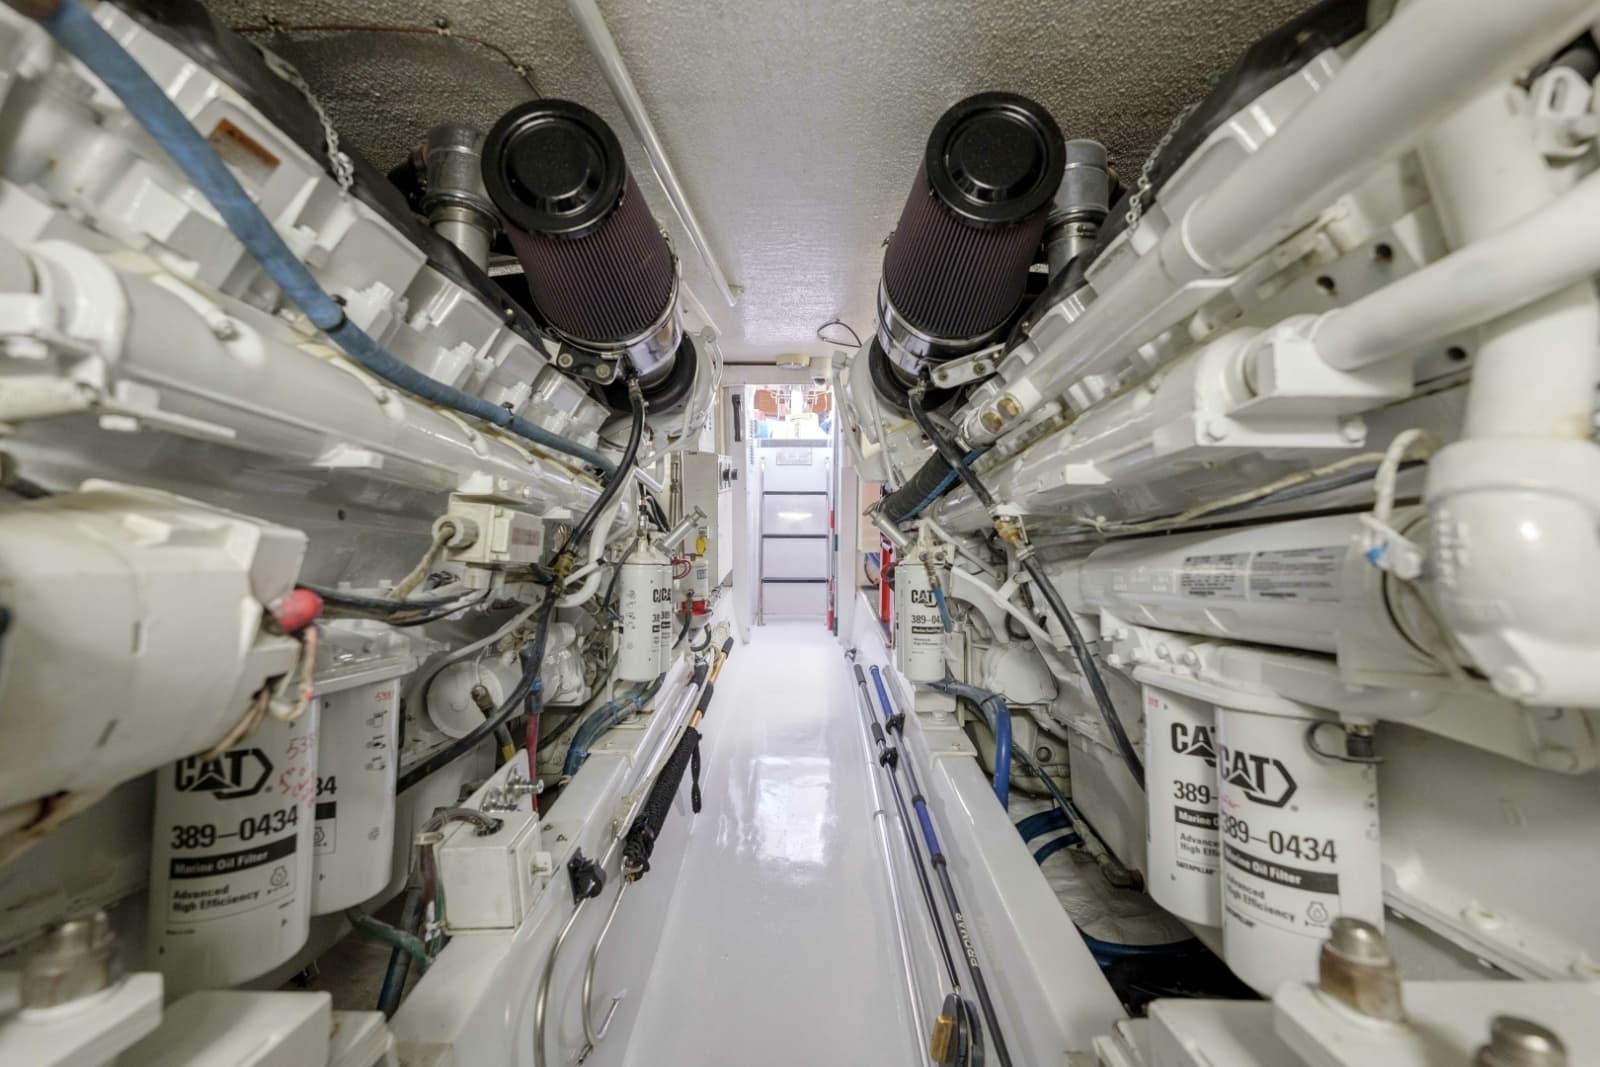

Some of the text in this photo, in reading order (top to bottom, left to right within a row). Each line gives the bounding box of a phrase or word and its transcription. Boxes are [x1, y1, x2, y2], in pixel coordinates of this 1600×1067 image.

[911, 590, 937, 604] CAT
[1171, 722, 1216, 756] CA
[175, 749, 249, 792] CAT
[1218, 744, 1270, 794] CAT
[171, 804, 297, 849] 389-0434
[174, 851, 269, 875] Marine Oil Filter
[1252, 861, 1269, 876] Oil
[1269, 868, 1303, 885] Filter
[172, 902, 197, 914] High
[199, 890, 260, 910] Efficiency
[173, 884, 230, 899] Advanced
